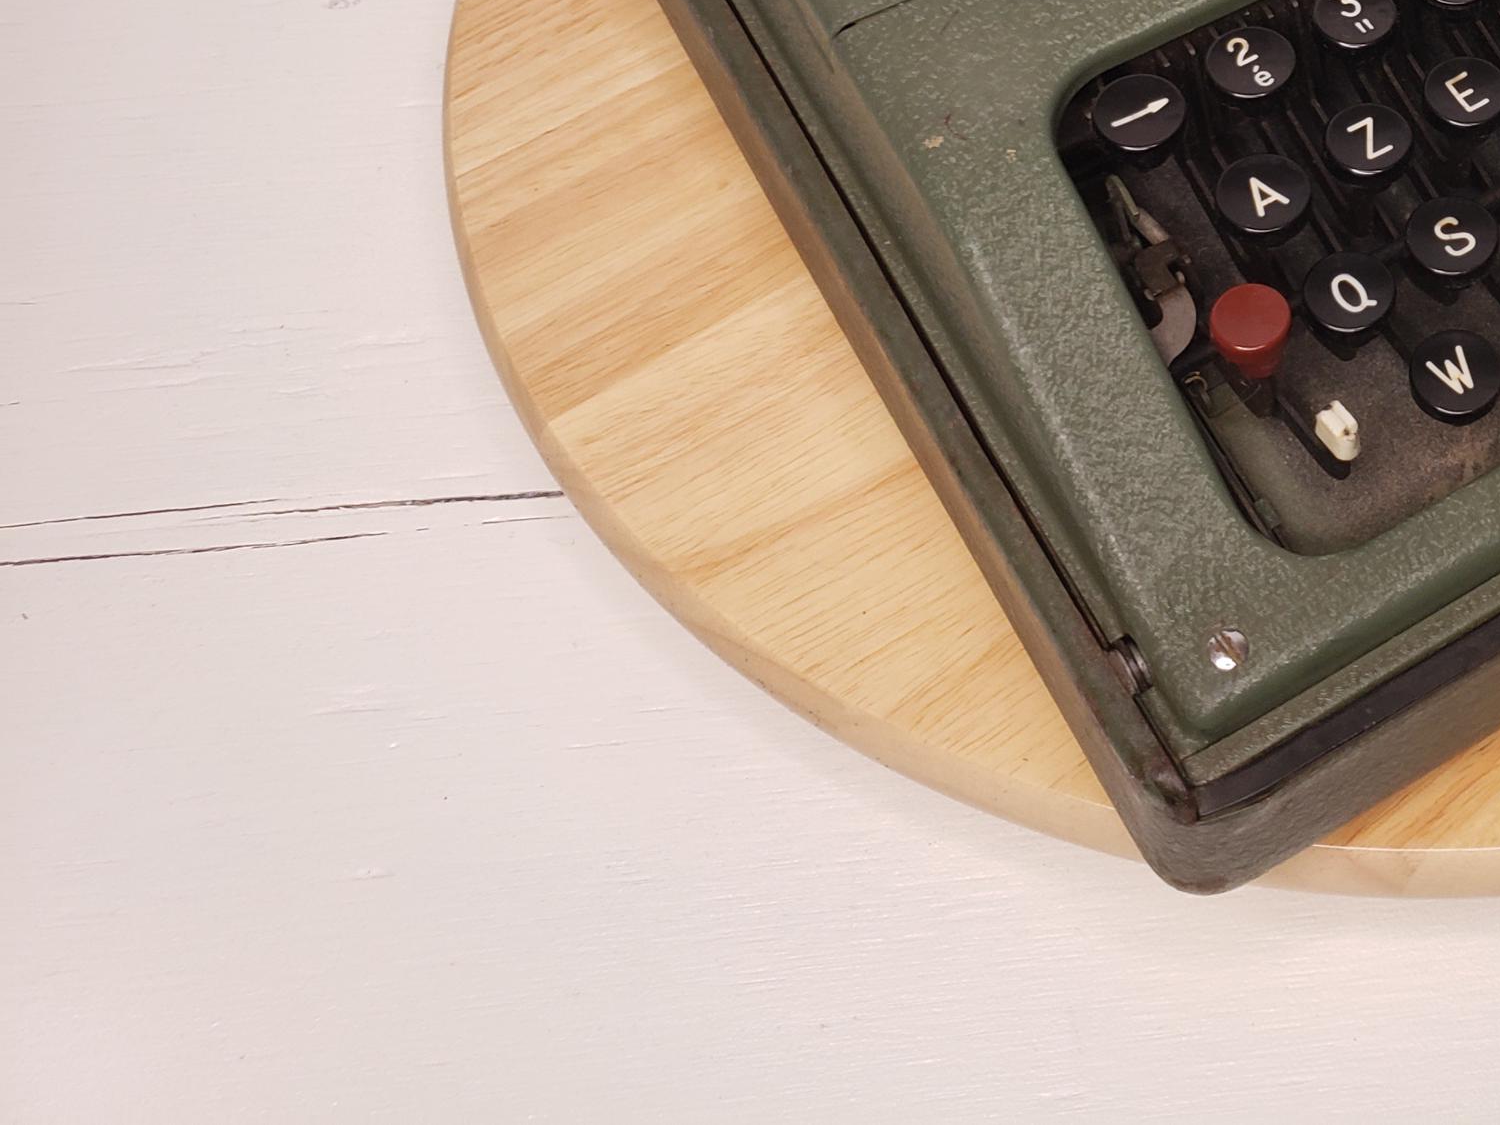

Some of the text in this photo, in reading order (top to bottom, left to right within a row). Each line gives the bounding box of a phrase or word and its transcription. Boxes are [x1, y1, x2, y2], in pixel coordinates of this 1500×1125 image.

[1226, 37, 1259, 67] 2
[1444, 71, 1490, 113] E
[1346, 116, 1394, 160] Z
[1249, 176, 1291, 218] A
[1433, 216, 1477, 257] S
[1330, 273, 1378, 314] Q
[1425, 344, 1475, 395] W
